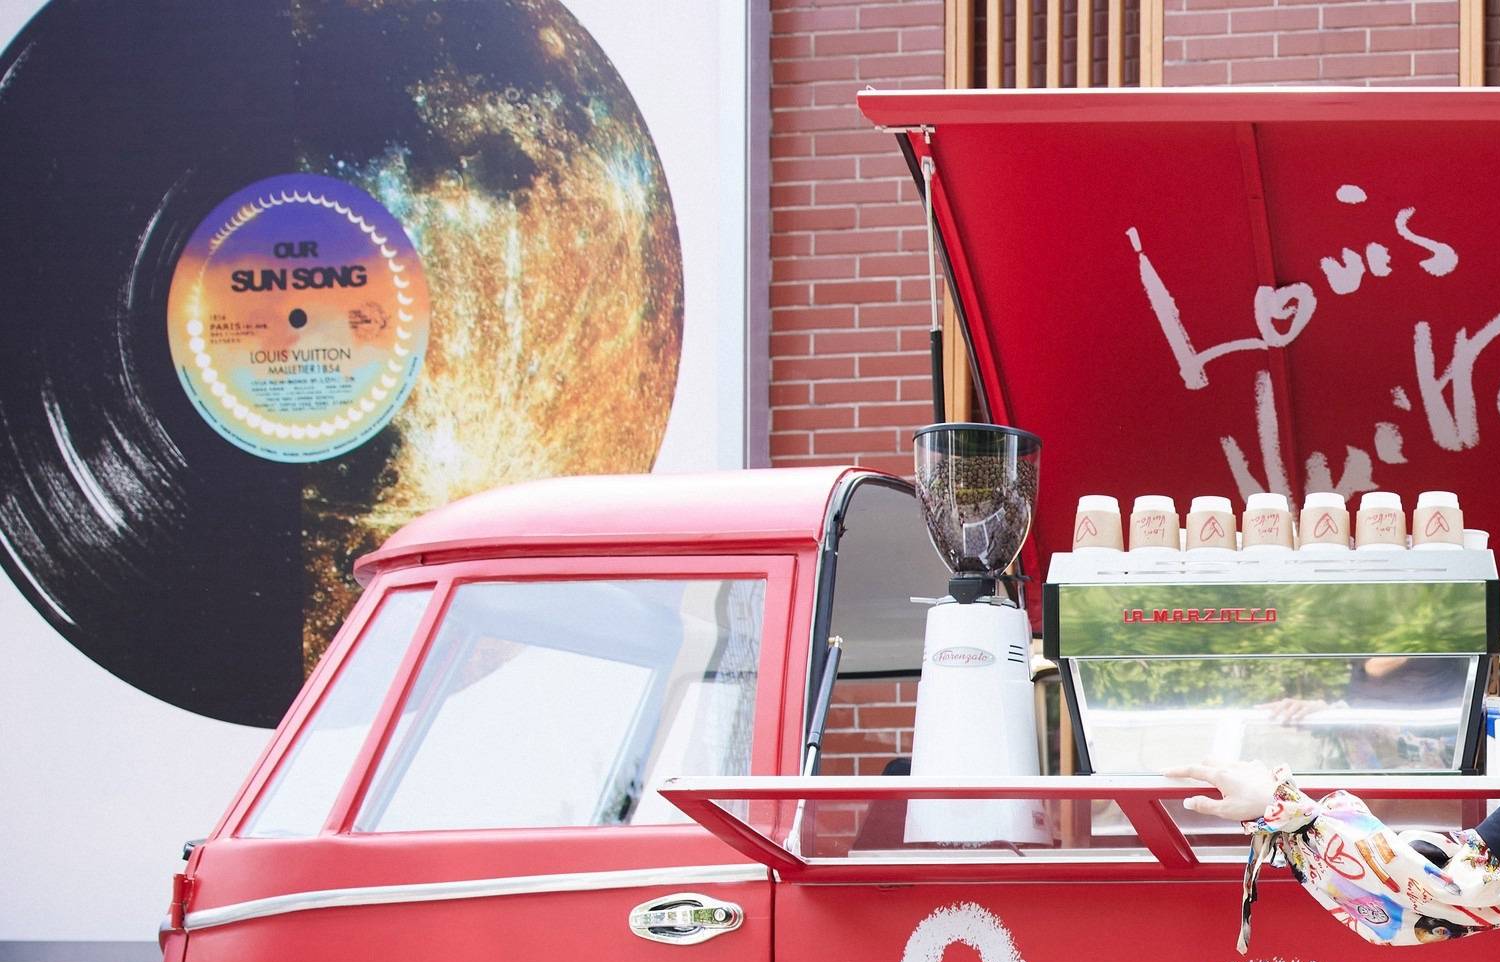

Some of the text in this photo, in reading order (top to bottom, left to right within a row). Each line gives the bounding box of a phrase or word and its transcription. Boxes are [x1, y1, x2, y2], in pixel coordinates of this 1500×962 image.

[273, 241, 319, 259] OUR
[231, 265, 368, 293] SUN SONG
[1126, 184, 1459, 390] Louis
[250, 347, 351, 364] LOUIS VUITTON
